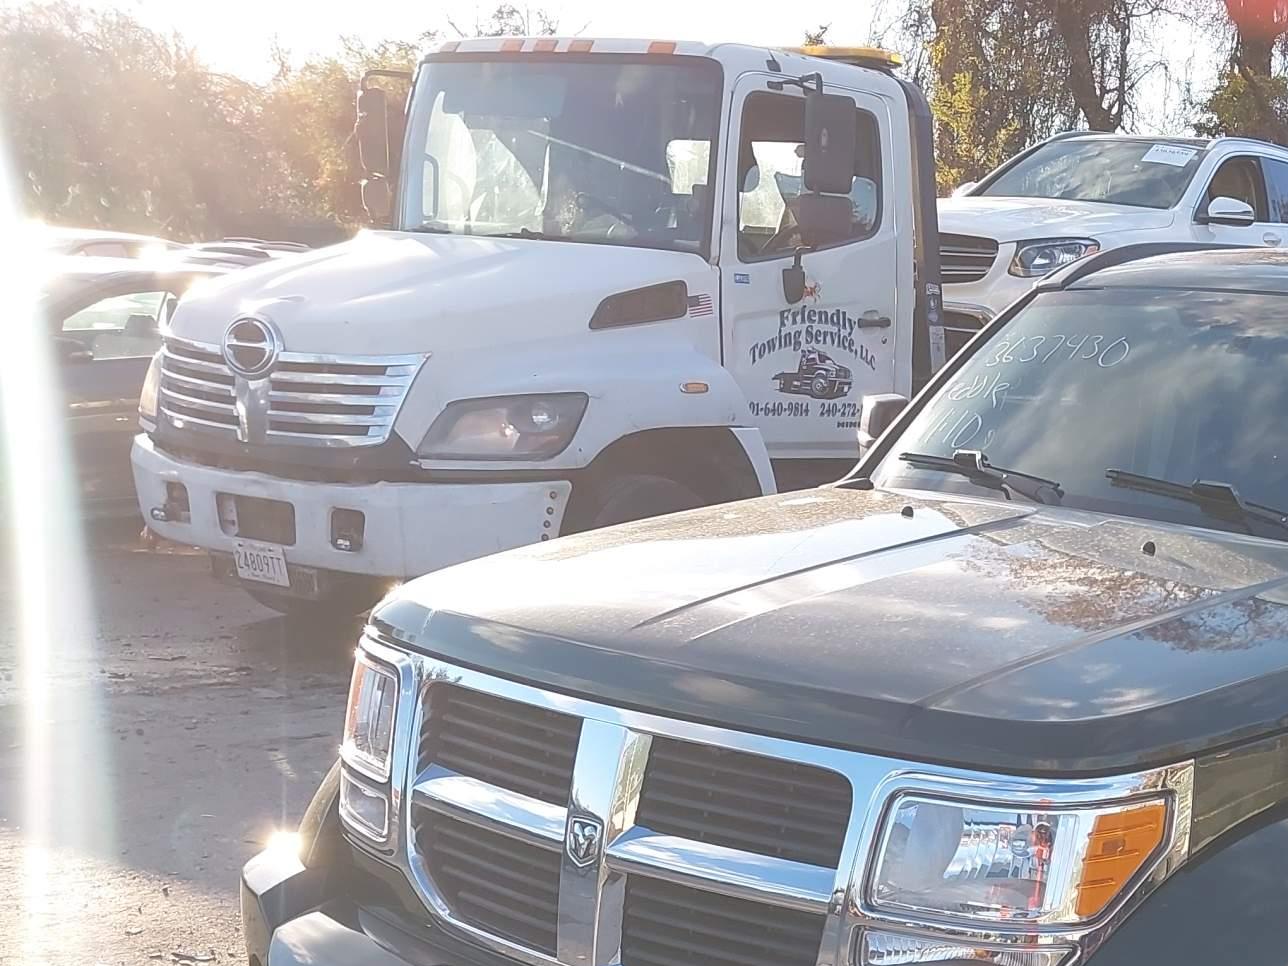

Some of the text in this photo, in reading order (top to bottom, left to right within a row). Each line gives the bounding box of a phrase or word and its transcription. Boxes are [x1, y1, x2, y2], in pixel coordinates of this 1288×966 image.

[779, 305, 857, 337] Friendly
[749, 325, 875, 371] Towing Service, LLC
[820, 402, 863, 417] 240-272-
